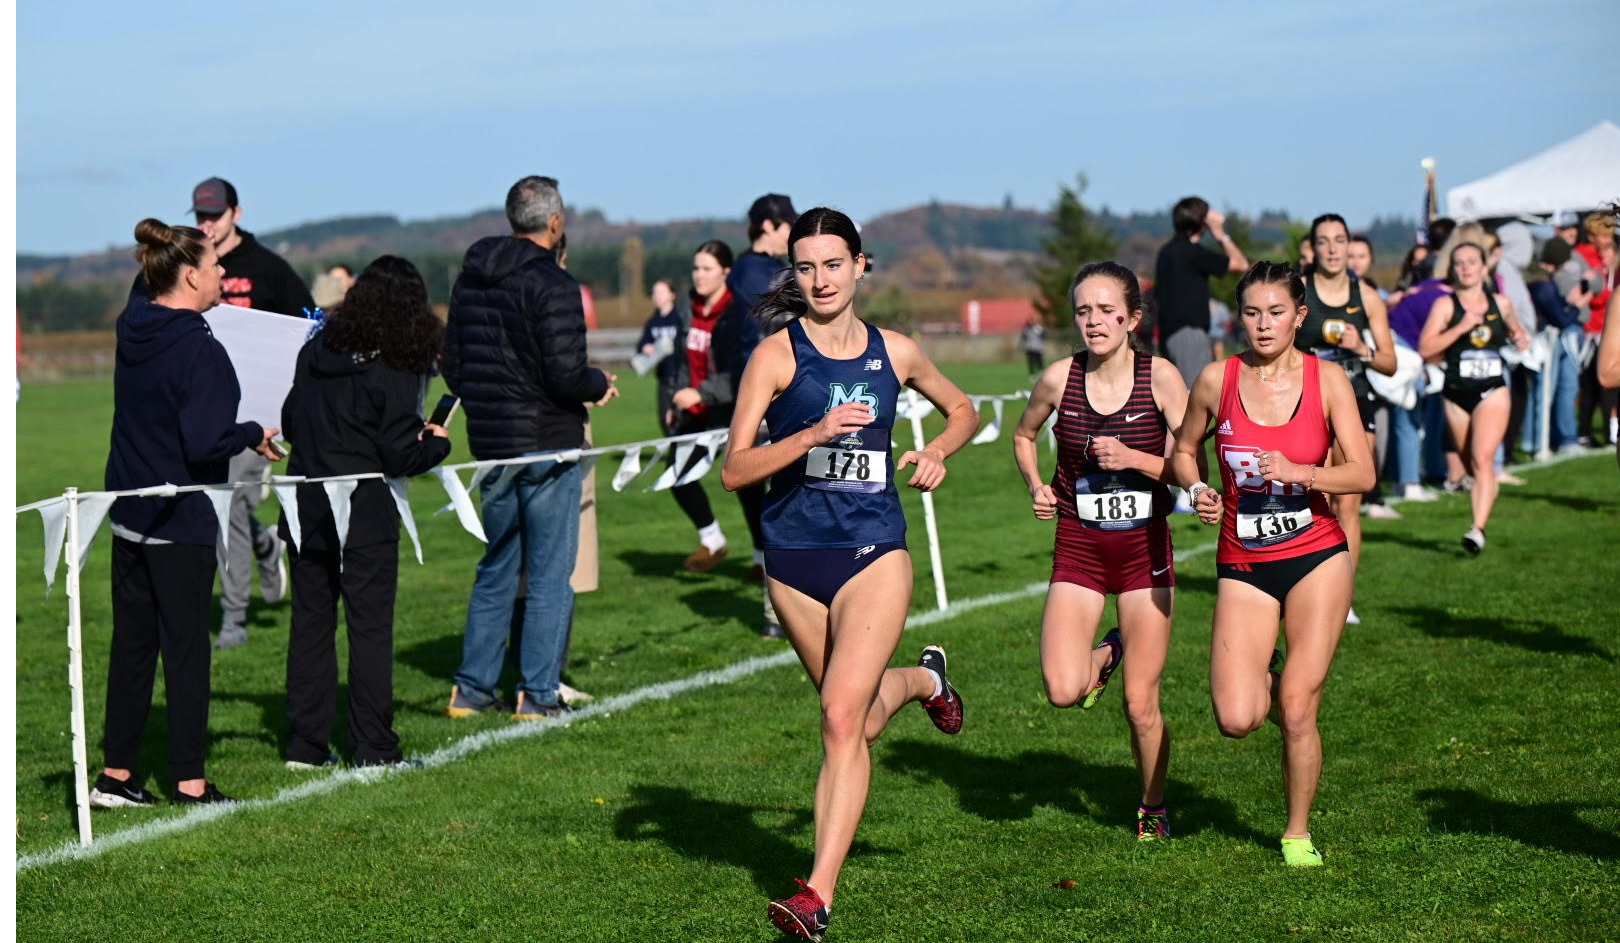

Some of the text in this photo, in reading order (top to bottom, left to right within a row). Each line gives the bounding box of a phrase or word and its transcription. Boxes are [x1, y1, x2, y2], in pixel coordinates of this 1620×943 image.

[825, 452, 870, 480] 178
[1094, 495, 1137, 520] 183
[1254, 515, 1297, 539] 136
